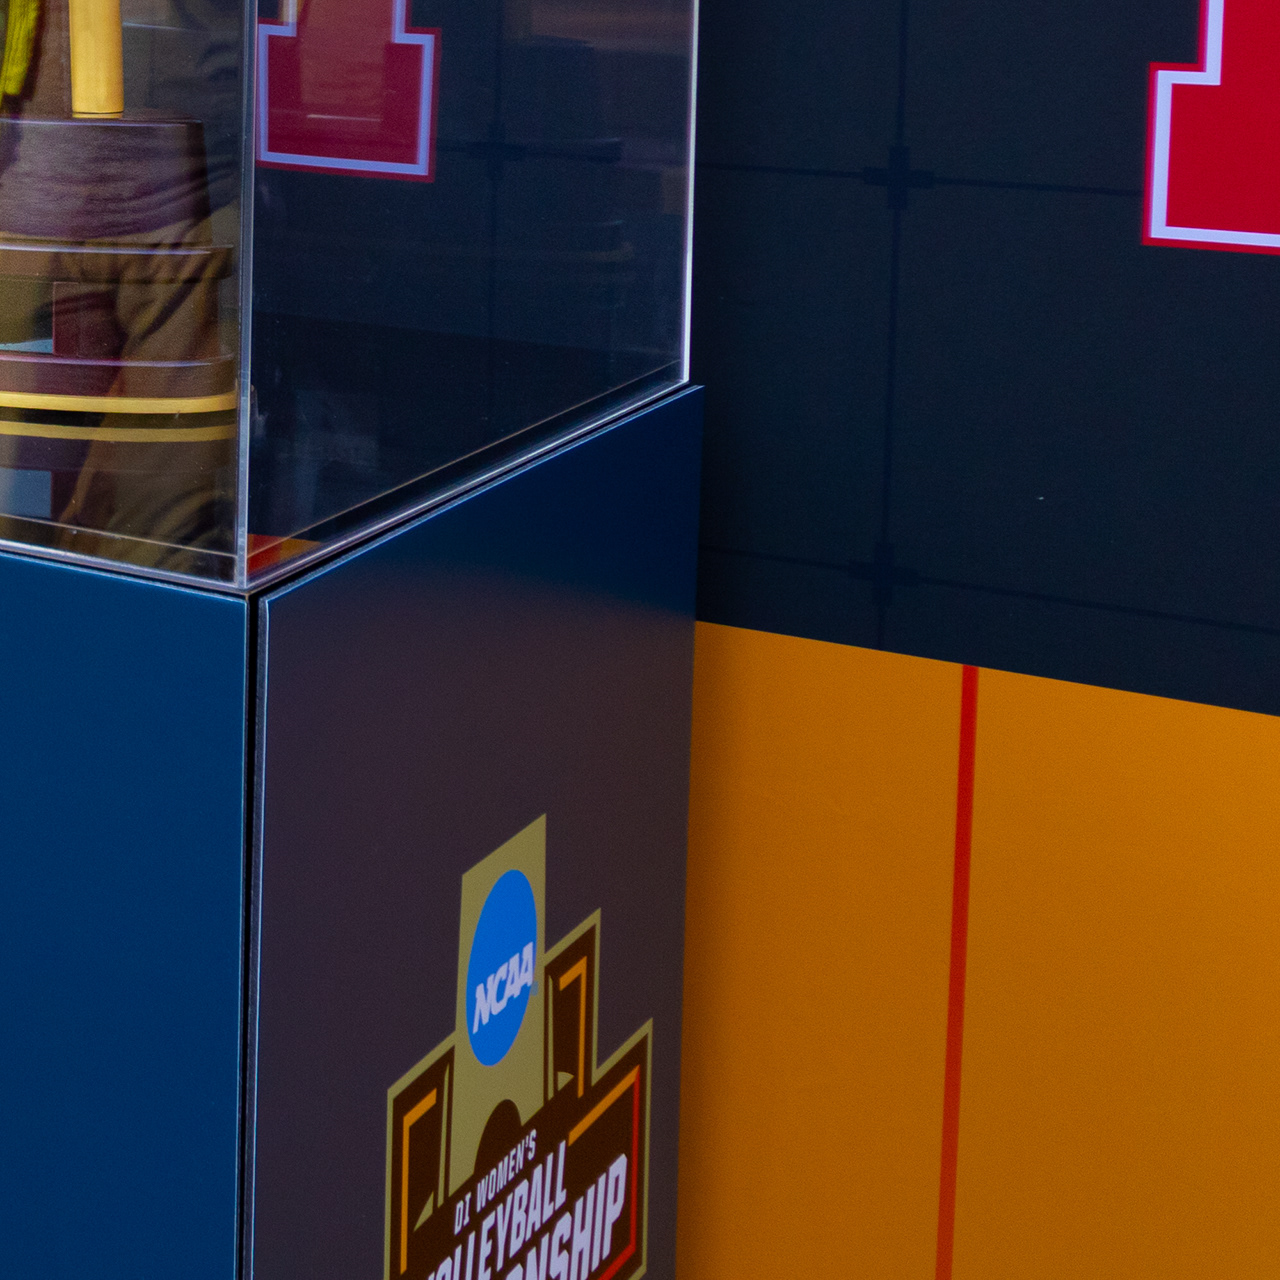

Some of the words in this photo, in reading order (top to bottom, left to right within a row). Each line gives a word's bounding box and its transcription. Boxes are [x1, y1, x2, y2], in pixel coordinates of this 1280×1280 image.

[473, 941, 533, 1034] NCAA
[454, 1192, 471, 1235] DI
[476, 1128, 537, 1213] WOMEN'S
